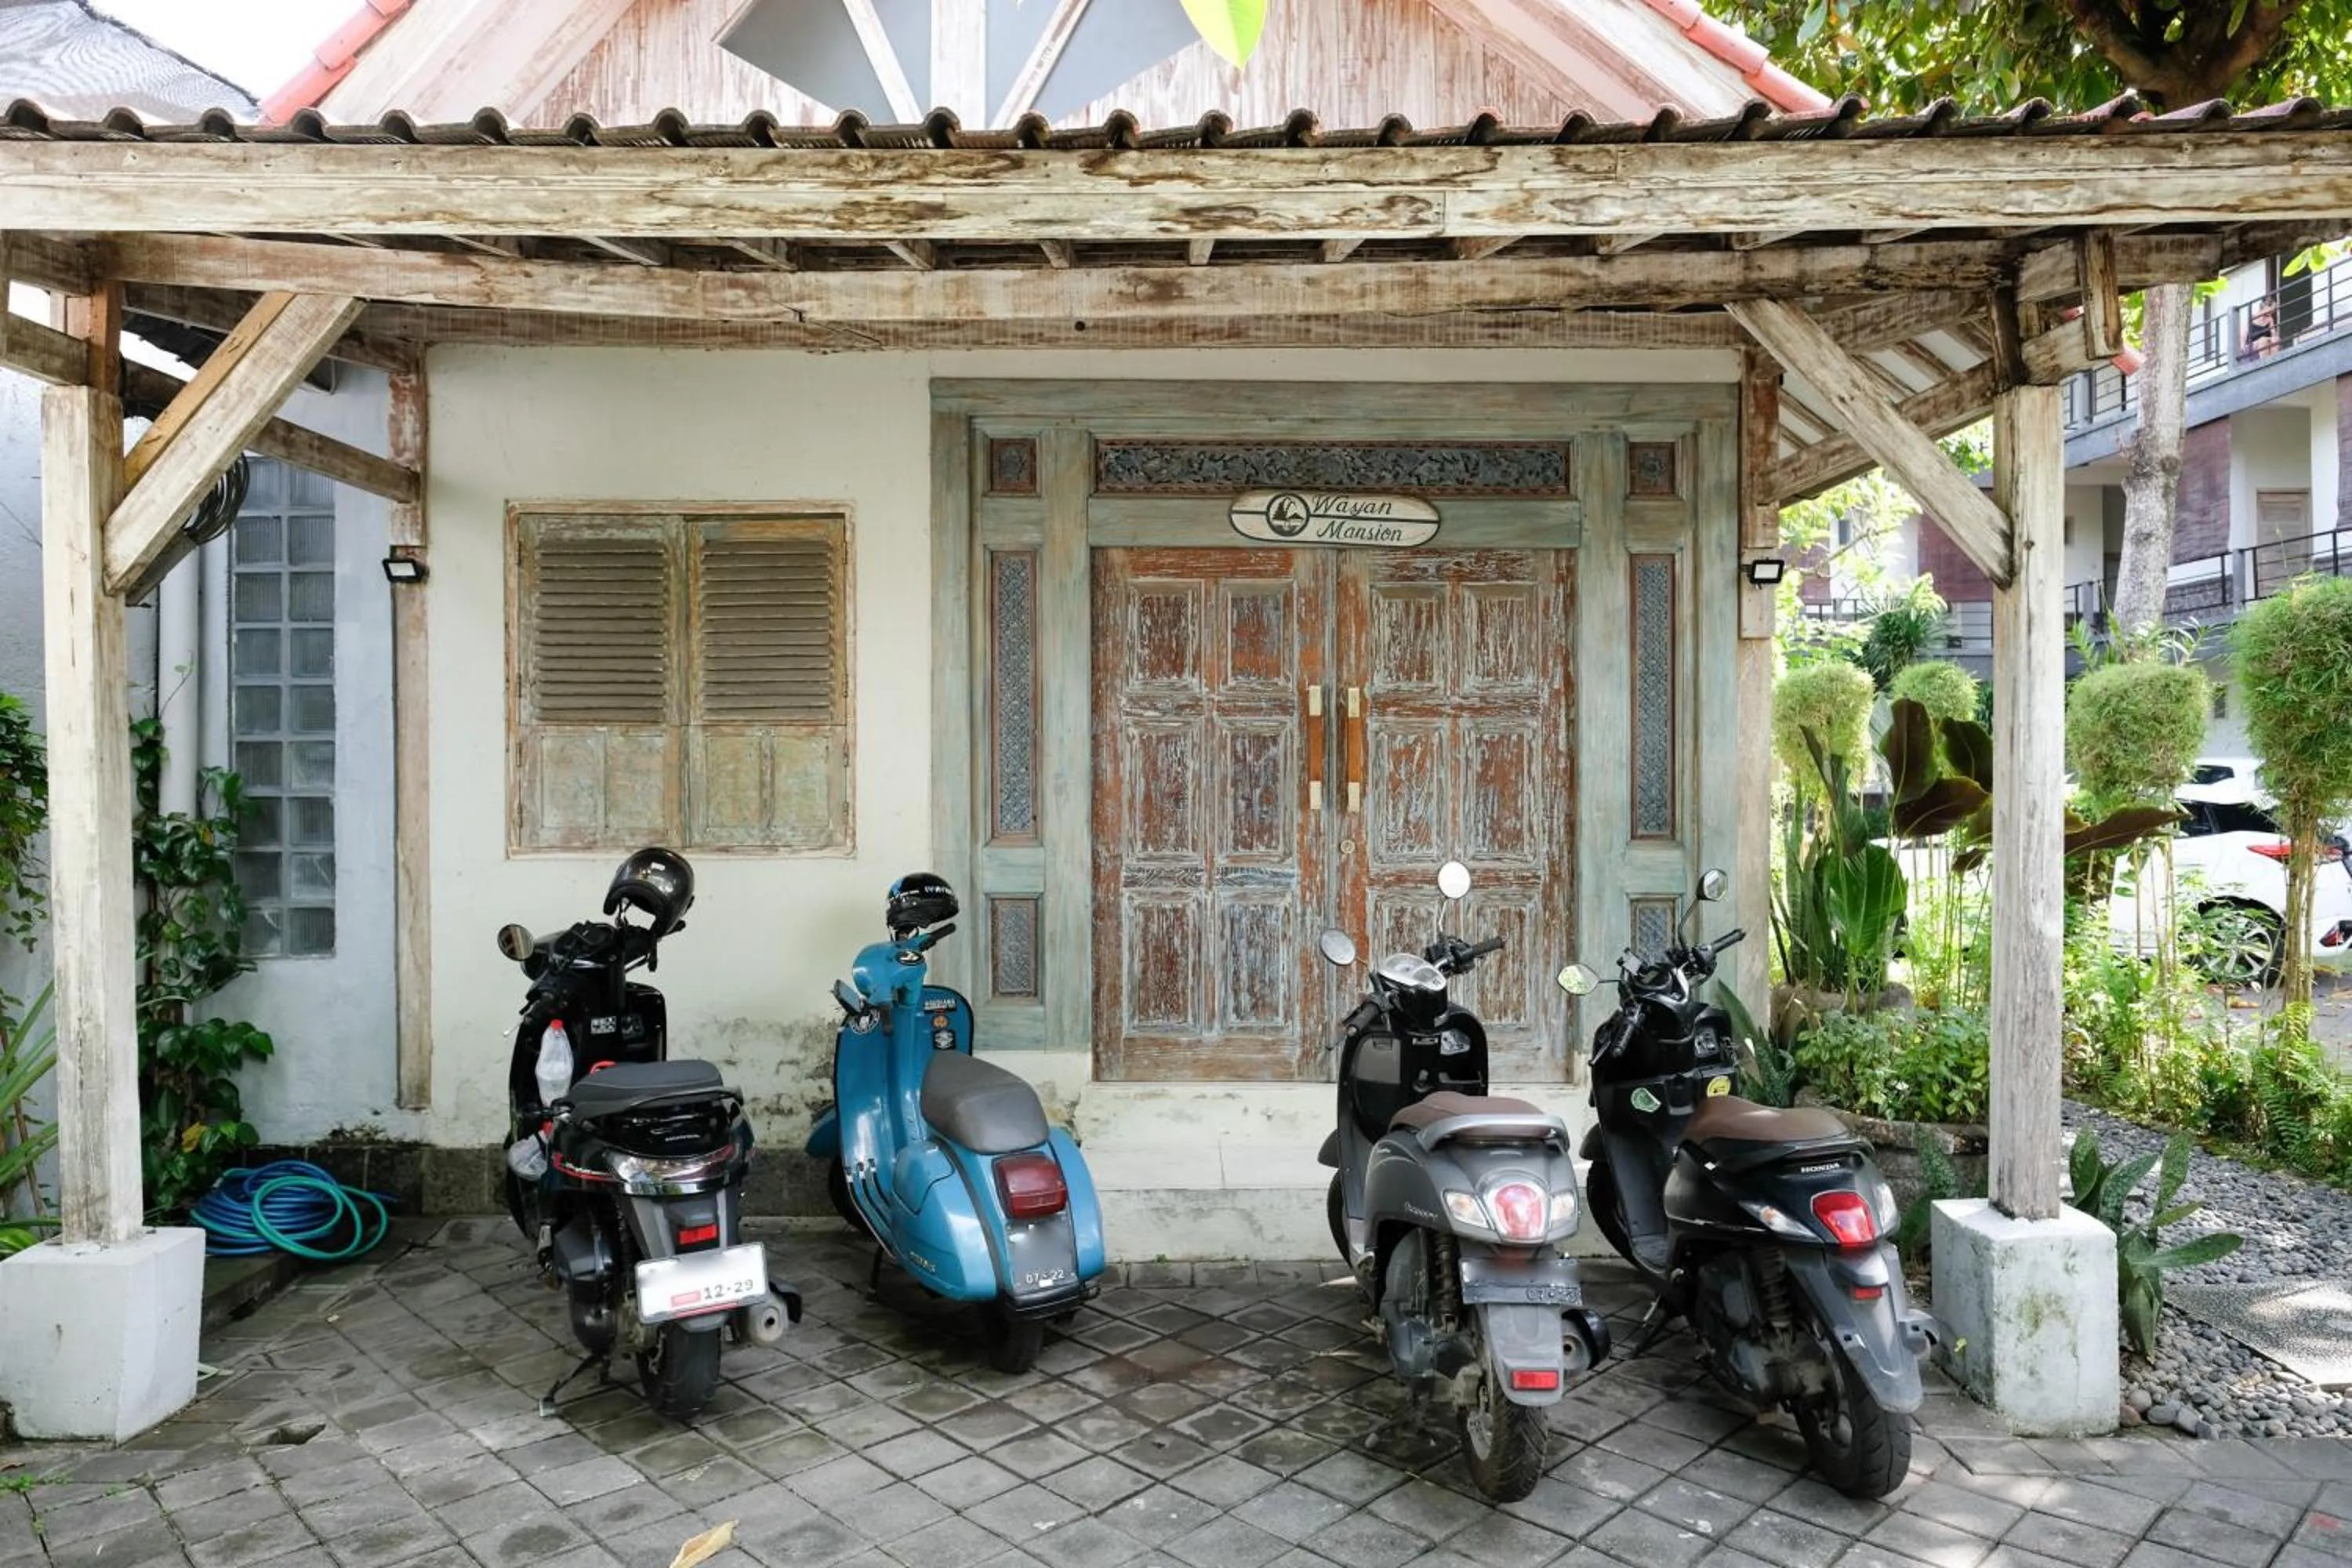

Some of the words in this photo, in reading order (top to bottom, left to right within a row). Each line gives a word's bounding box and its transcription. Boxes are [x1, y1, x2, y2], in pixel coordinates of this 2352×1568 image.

[1312, 494, 1392, 516] Wayan
[1316, 520, 1403, 542] Mansion
[1801, 1162, 1840, 1173] HONDA
